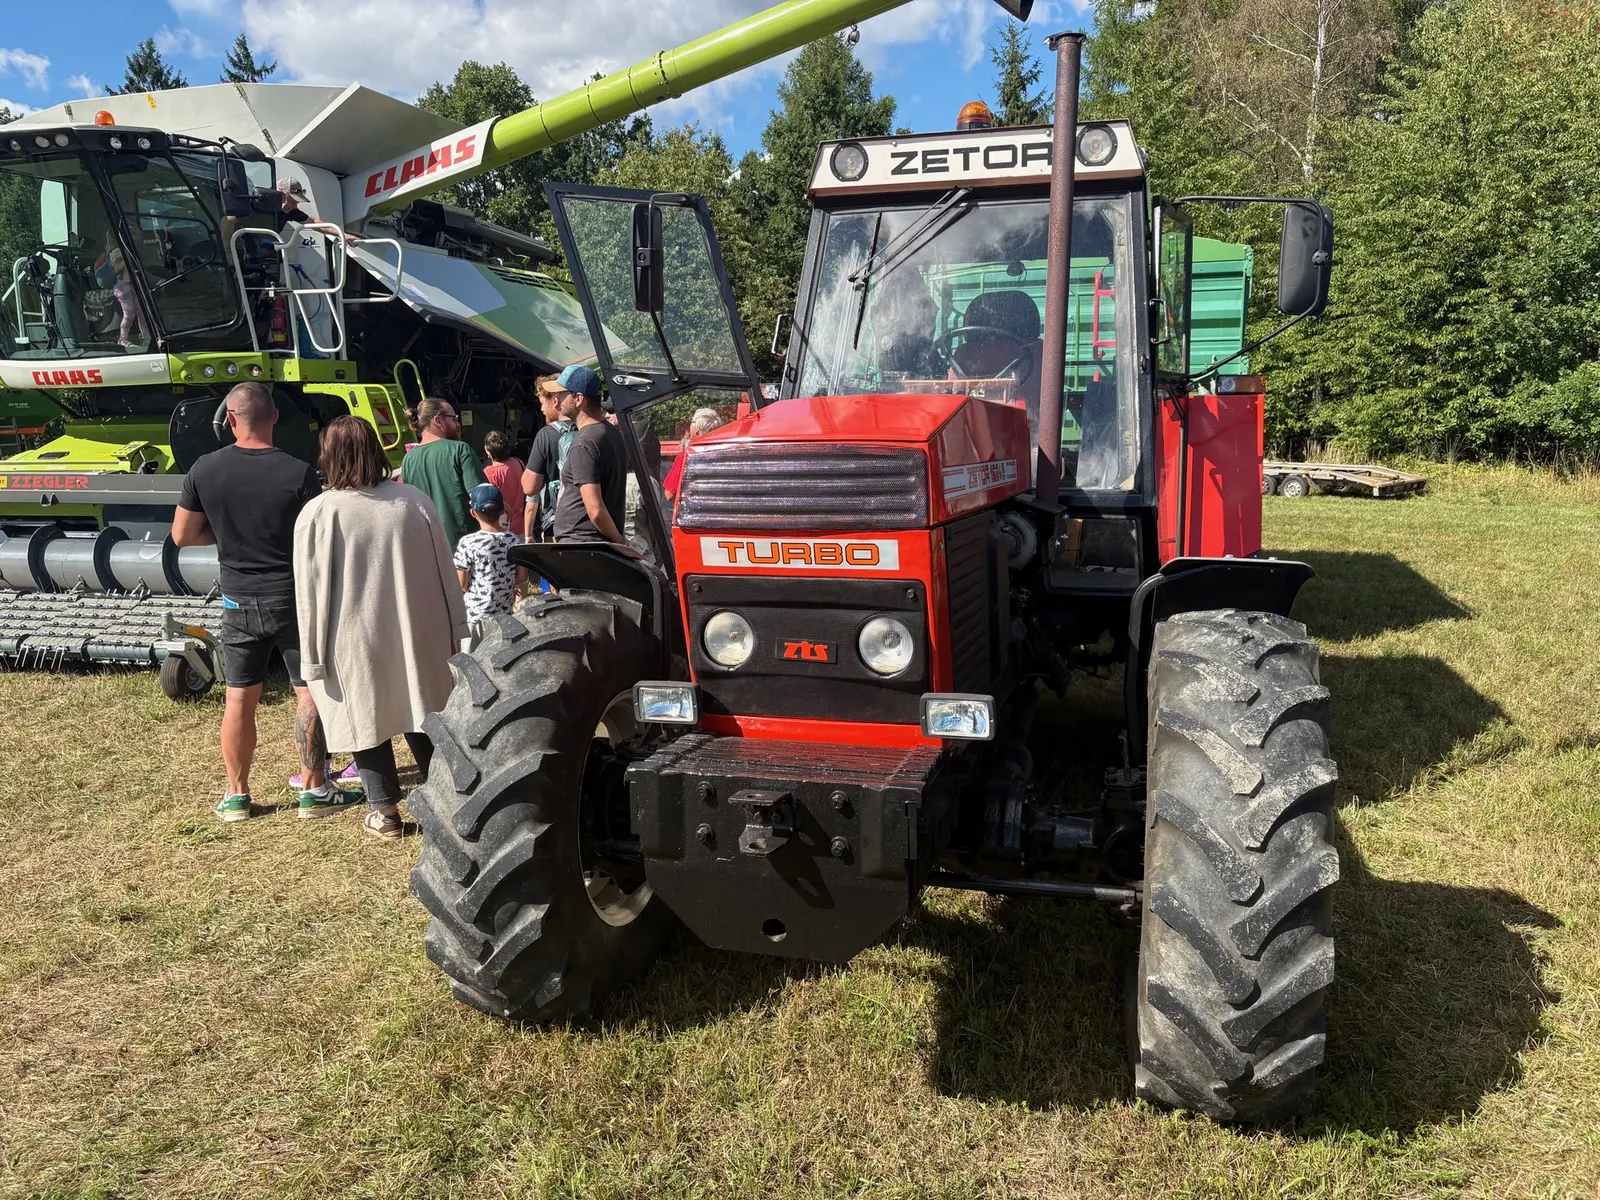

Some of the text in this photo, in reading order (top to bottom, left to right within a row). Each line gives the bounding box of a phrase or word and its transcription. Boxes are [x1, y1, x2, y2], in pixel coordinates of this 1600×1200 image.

[365, 135, 476, 198] CLAAS
[891, 141, 1053, 175] ZETOR
[32, 369, 103, 386] CLAAS
[11, 475, 89, 489] ZIEGLER
[967, 464, 990, 489] ZETOR
[718, 541, 880, 566] TURBO
